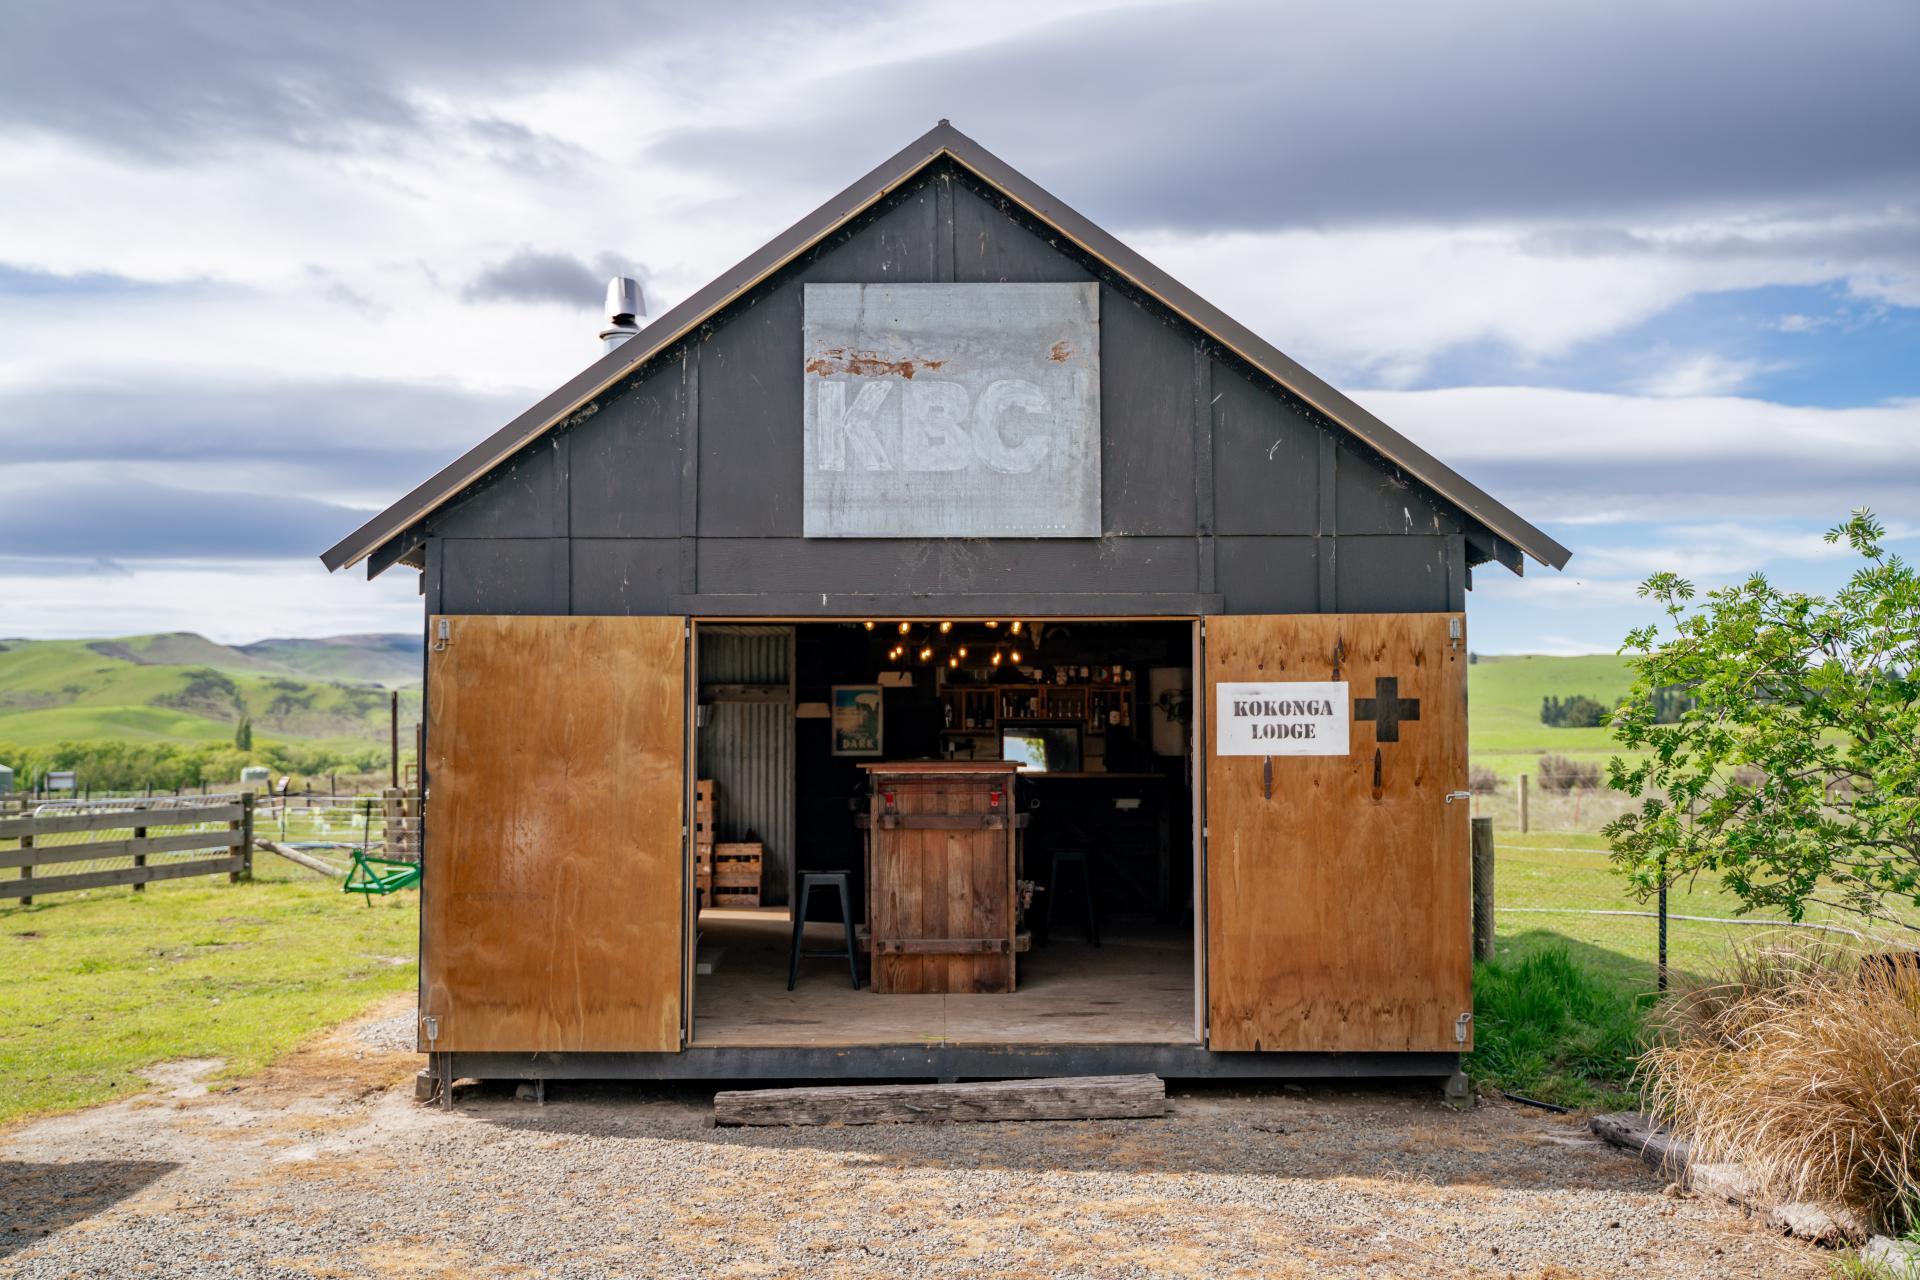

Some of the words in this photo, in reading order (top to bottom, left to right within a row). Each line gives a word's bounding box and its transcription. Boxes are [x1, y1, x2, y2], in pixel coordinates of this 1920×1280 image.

[817, 379, 1051, 474] KBC
[1233, 700, 1334, 717] KOKONGA
[1251, 724, 1316, 739] LODGE
[842, 738, 874, 749] DARK
